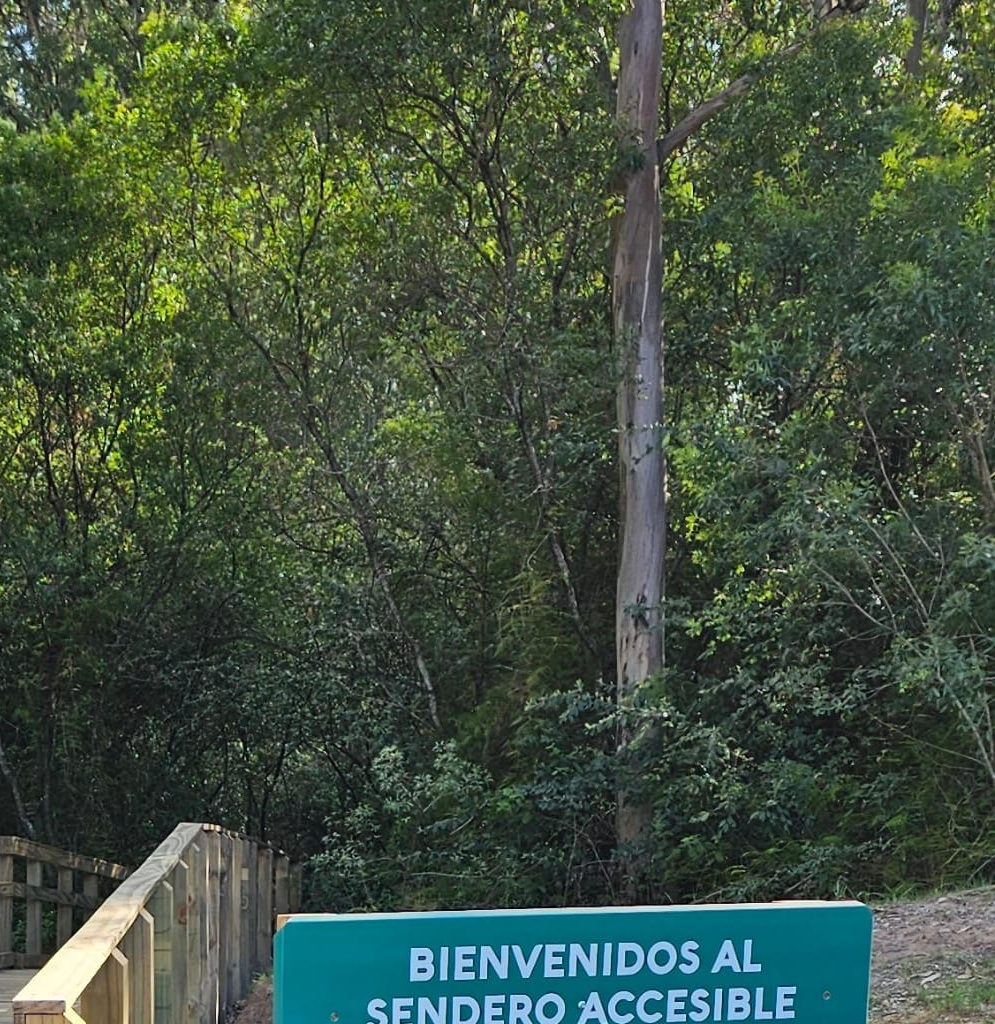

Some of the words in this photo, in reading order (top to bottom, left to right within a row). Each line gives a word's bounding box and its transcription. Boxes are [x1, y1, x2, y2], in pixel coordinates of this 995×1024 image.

[410, 941, 699, 981] BIENVENIDOS
[711, 940, 761, 973] AL
[577, 987, 796, 1024] ACCESIBLE
